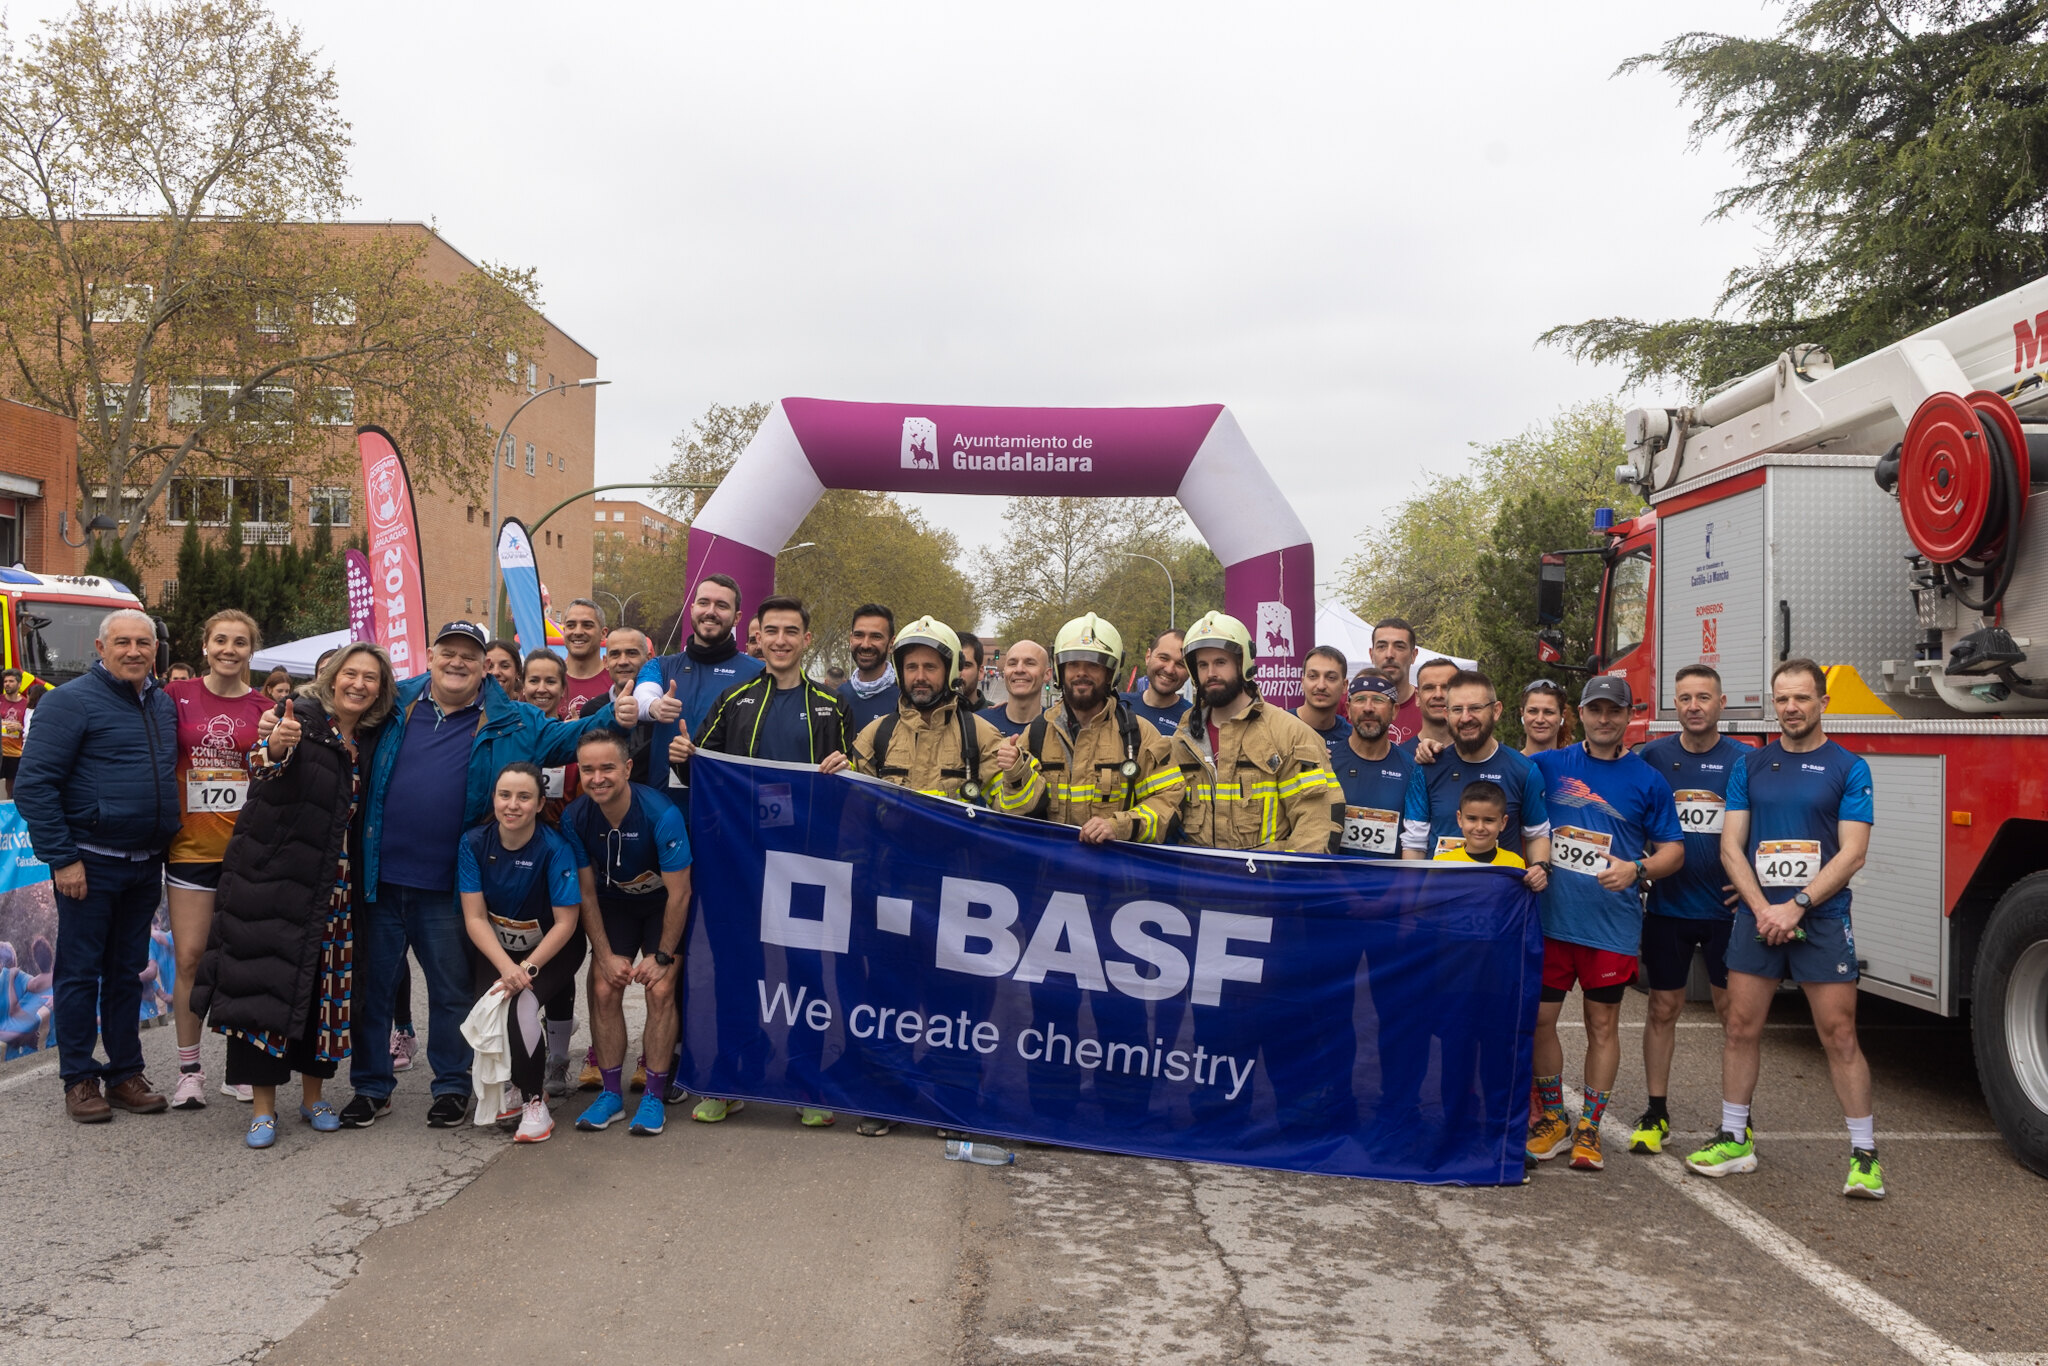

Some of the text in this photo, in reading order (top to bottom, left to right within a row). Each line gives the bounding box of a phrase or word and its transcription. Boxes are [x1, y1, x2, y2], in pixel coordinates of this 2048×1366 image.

[953, 433, 1093, 450] Ayuntamiento de
[952, 451, 1093, 472] Guadalajara
[1696, 602, 1724, 616] BOMBEROS
[191, 746, 217, 757] XXIII
[192, 758, 241, 768] BOMBEROS
[201, 788, 237, 804] 170
[1679, 808, 1719, 825] 407
[1348, 825, 1385, 844] 395
[1558, 844, 1595, 866] 396
[1765, 860, 1808, 878] 402
[500, 931, 528, 946] 171
[935, 875, 1273, 1007] BASF
[757, 979, 1255, 1100] We create chemistry
